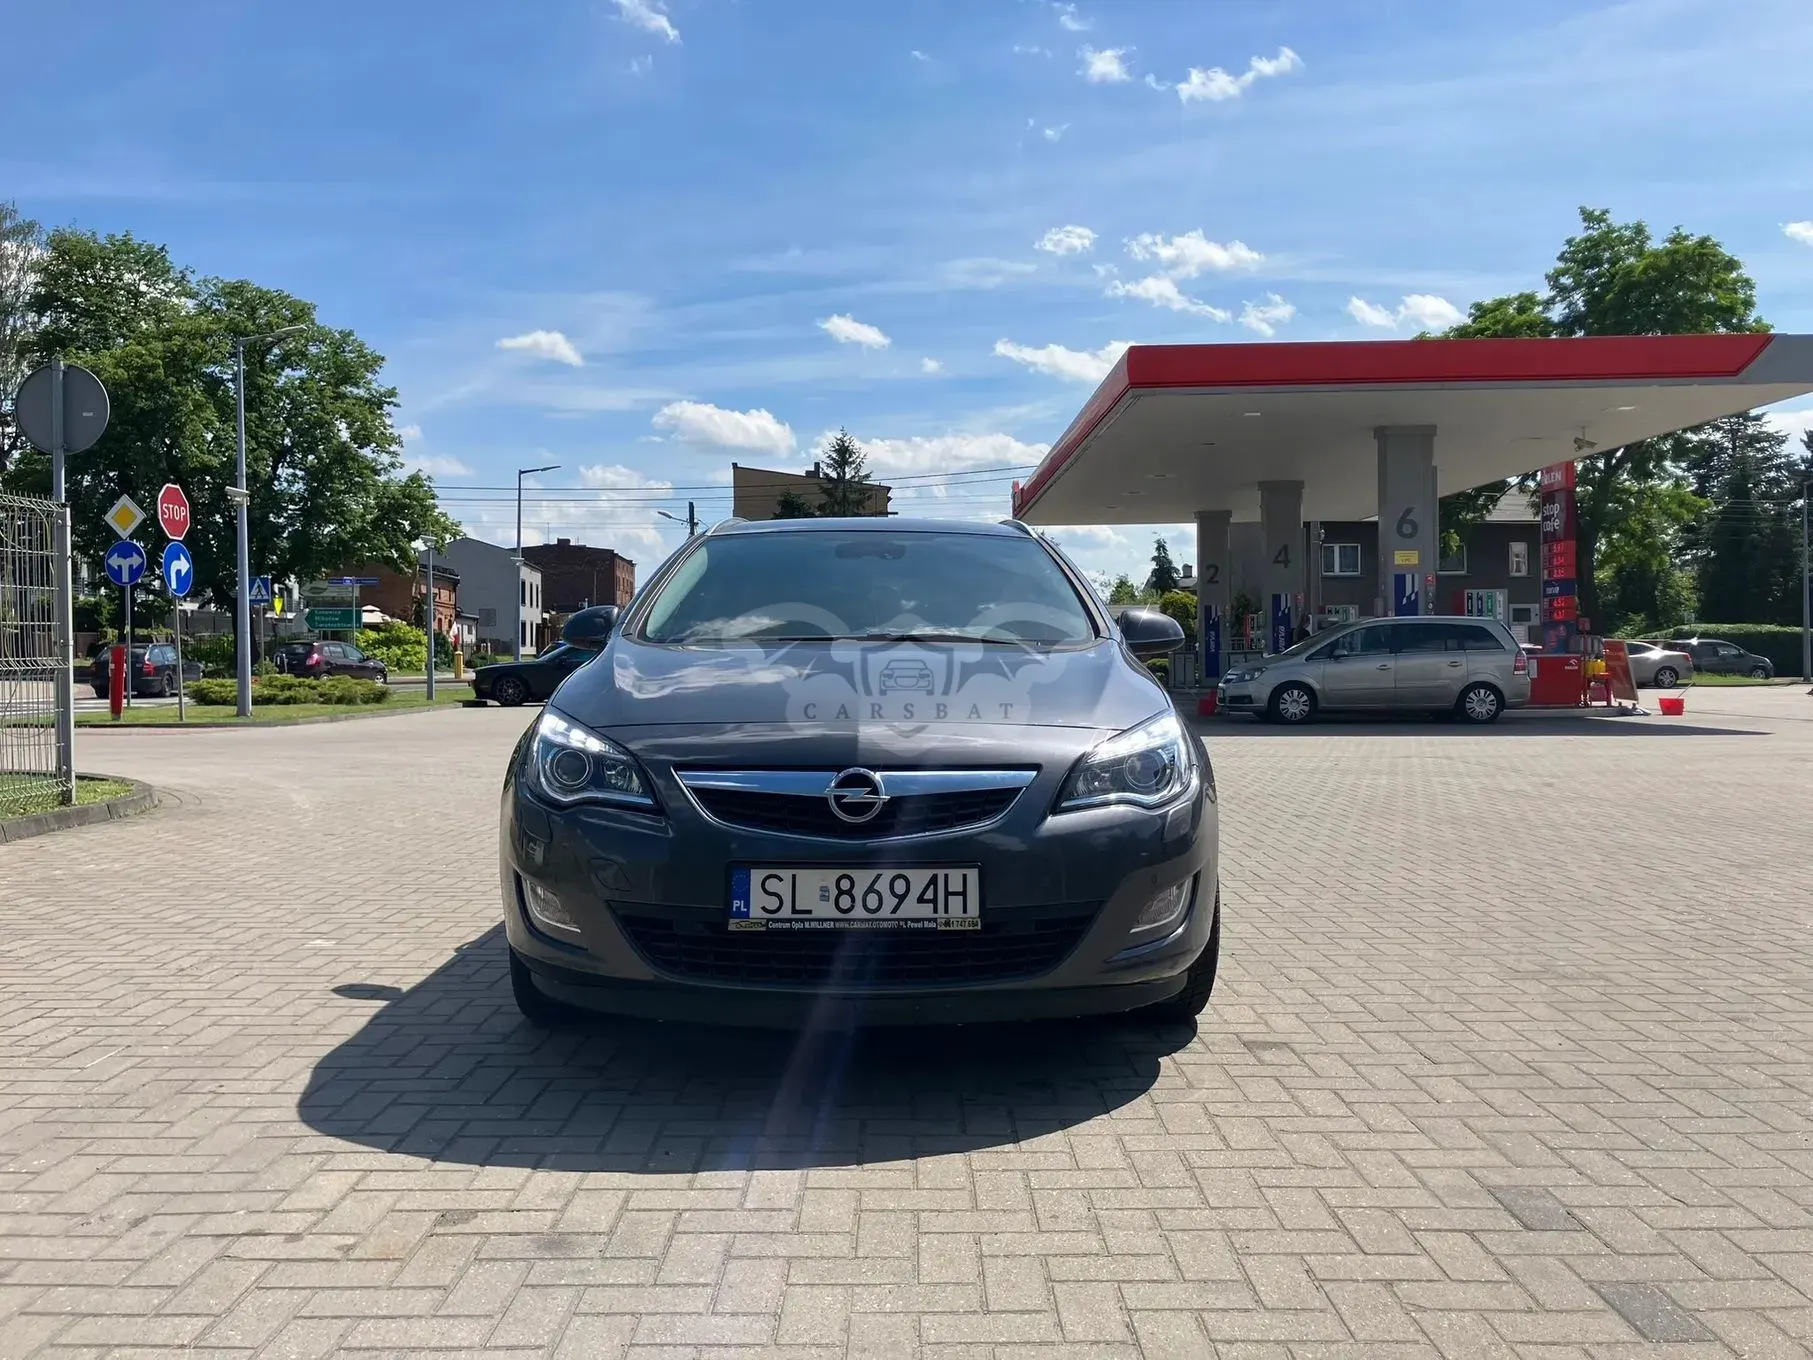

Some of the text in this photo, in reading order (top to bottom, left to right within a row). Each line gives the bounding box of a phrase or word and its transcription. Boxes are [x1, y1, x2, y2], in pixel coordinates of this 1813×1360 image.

[162, 503, 187, 521] STOP
[1543, 503, 1560, 517] stop
[1396, 507, 1419, 539] 6
[1273, 544, 1291, 569] 4
[1206, 564, 1220, 584] 2
[760, 873, 968, 915] SL 8694H
[732, 900, 748, 912] PL
[768, 921, 791, 929] Centrum
